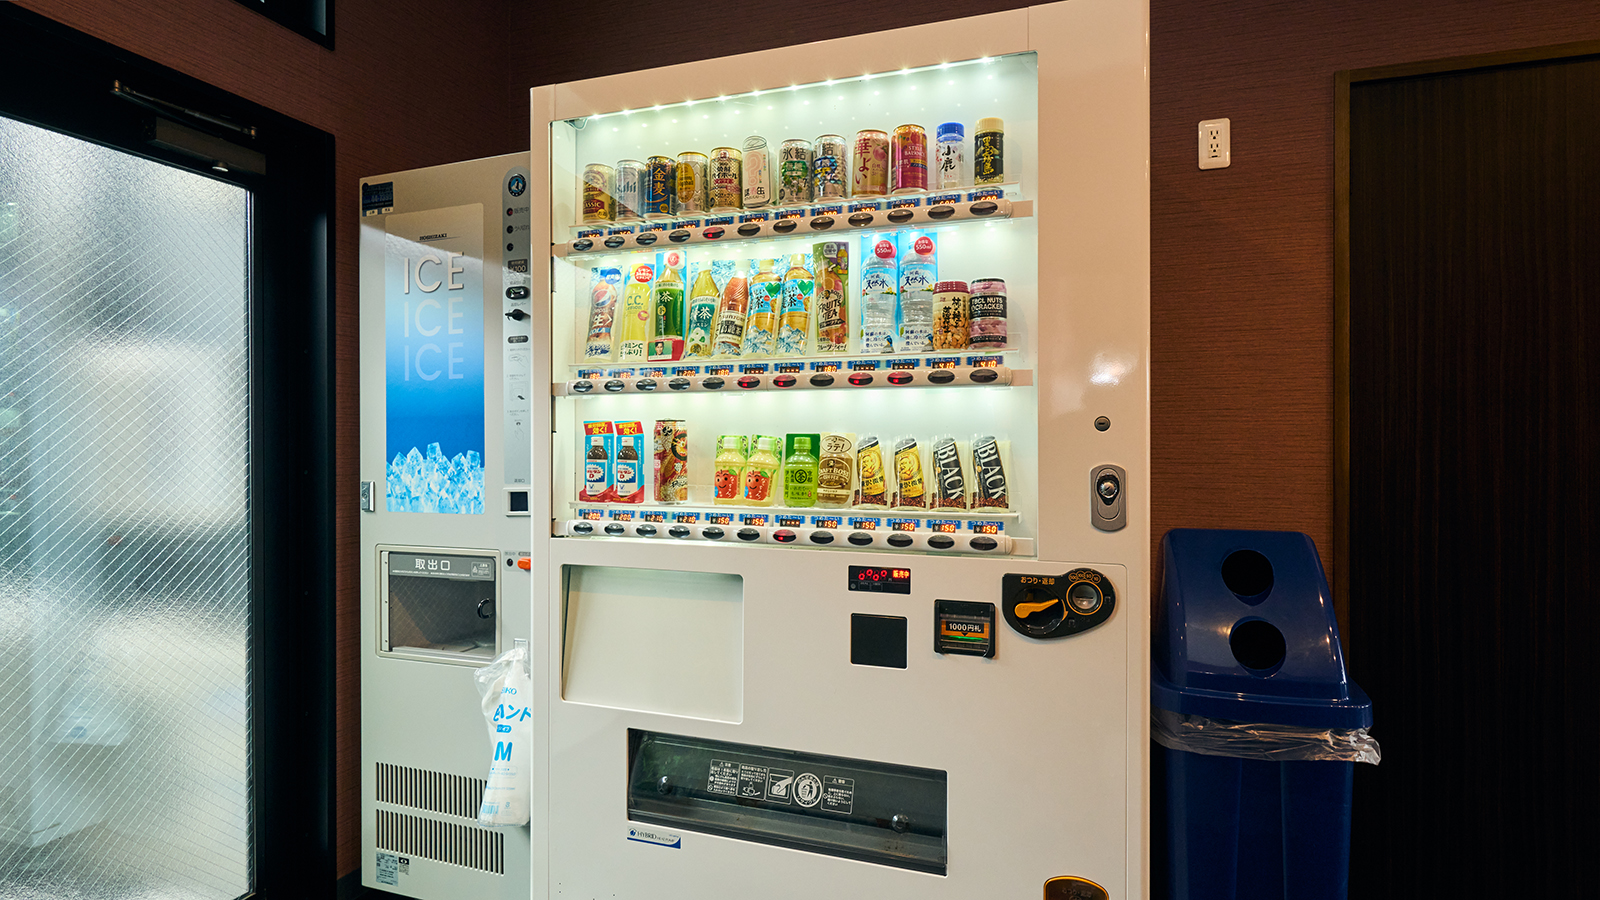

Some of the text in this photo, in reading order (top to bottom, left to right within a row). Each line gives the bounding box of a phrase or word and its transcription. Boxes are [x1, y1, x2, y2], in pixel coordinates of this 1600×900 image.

[782, 148, 806, 160] 氷結
[940, 145, 956, 172] 小鹿
[854, 138, 872, 184] 華よい
[653, 168, 667, 196] 金麦
[404, 252, 465, 294] ICE
[866, 278, 889, 290] 天然水
[904, 275, 929, 286] 天然水
[626, 295, 644, 306] C.C.
[819, 300, 841, 314] FRUITS
[404, 297, 464, 338] ICE
[822, 308, 838, 320] TEA
[404, 342, 464, 381] ICE
[827, 443, 844, 452] ラテ!
[938, 444, 964, 500] BLACK
[977, 442, 1006, 500] BLACK
[415, 558, 450, 571] 取出口
[893, 569, 910, 579] 販売中
[1020, 576, 1055, 585] おつり・返却
[949, 623, 981, 632] 1000円札
[494, 741, 512, 761] M
